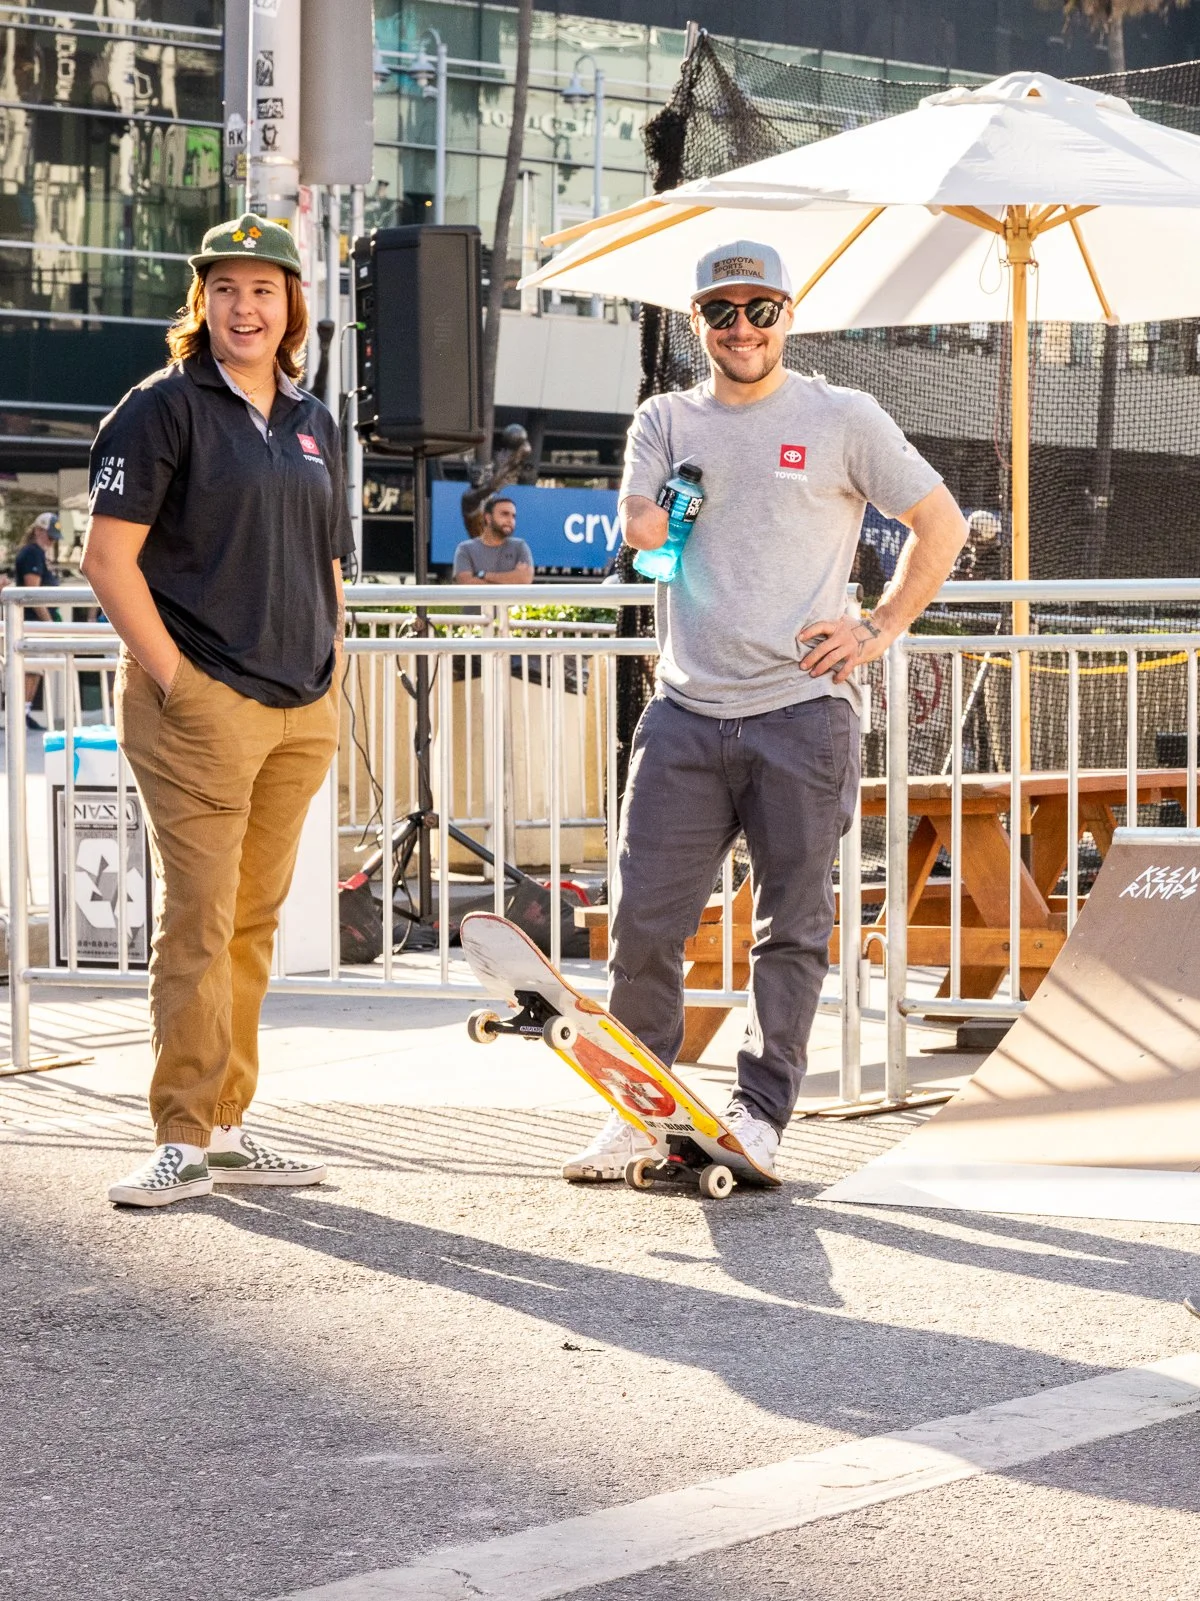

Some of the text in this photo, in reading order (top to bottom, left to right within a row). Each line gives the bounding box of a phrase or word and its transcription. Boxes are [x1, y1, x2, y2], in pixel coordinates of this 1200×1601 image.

[722, 256, 754, 265] TOYOTA
[714, 263, 743, 274] SPORTS
[726, 268, 764, 279] FESTIVAL
[774, 471, 808, 482] TOYOTA
[1118, 881, 1199, 900] RAMPS
